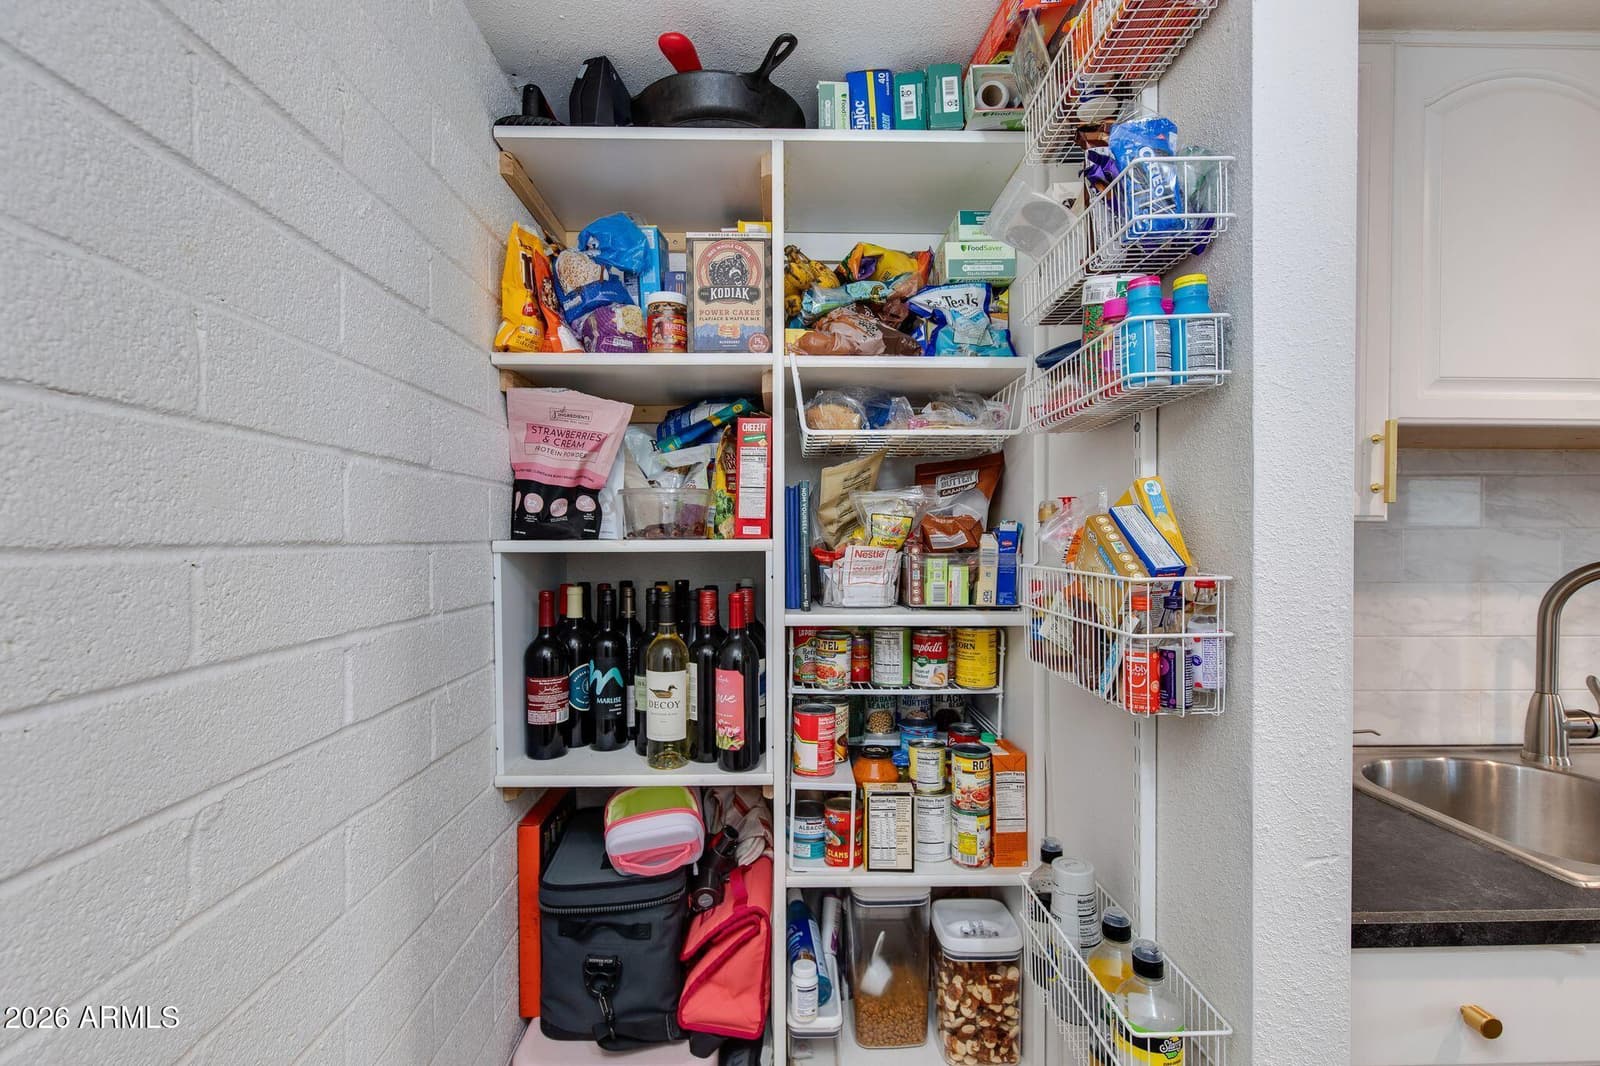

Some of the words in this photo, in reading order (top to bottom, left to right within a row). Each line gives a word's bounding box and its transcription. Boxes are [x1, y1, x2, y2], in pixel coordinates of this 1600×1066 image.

[878, 72, 886, 84] 40
[854, 100, 869, 130] iploc
[967, 244, 1003, 252] FoodSaver
[710, 287, 750, 301] KODIAK
[942, 293, 979, 309] Teal's
[531, 425, 602, 442] STRAWBERRIES
[542, 435, 550, 443] &
[553, 438, 586, 449] CREAM
[1127, 663, 1147, 675] bbly
[648, 701, 680, 710] DECOY
[827, 848, 849, 859] CLAMS
